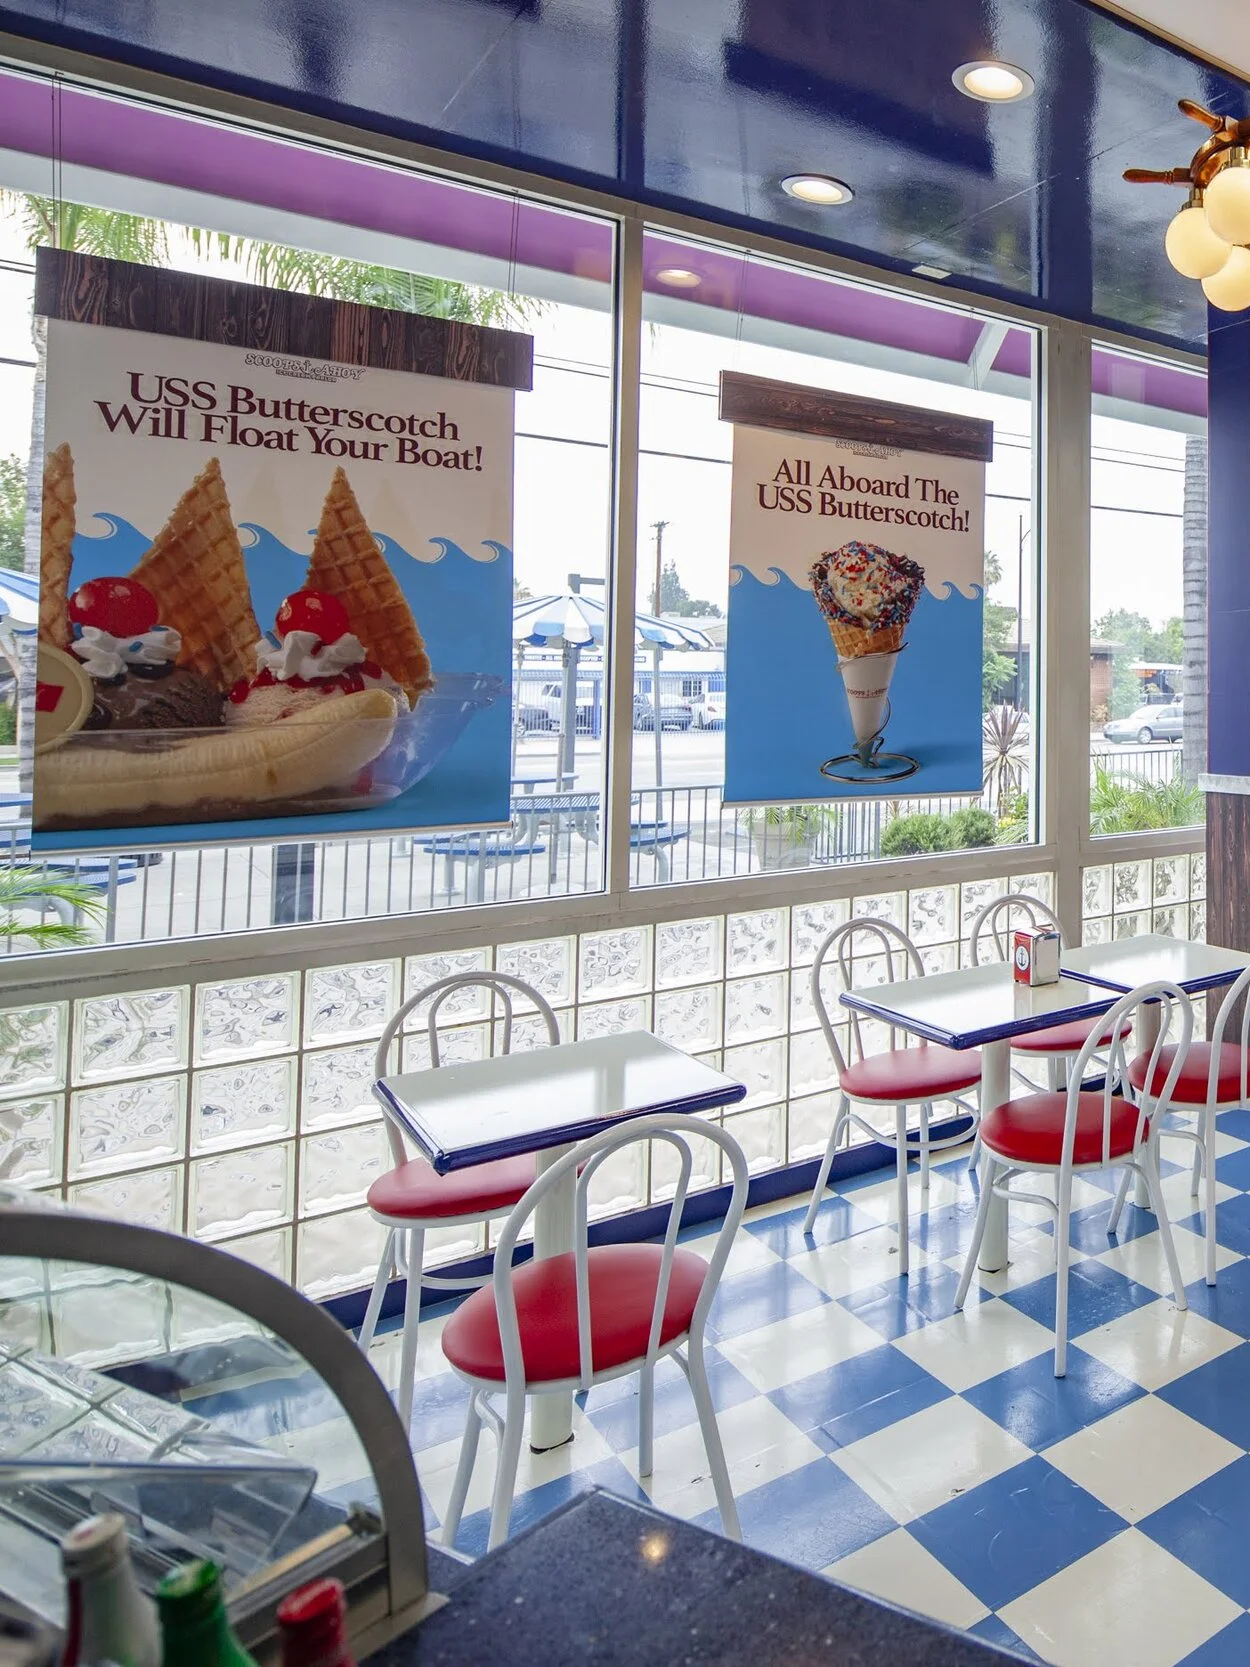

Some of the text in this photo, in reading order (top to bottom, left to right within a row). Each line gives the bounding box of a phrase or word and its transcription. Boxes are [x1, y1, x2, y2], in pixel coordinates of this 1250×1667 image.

[245, 353, 366, 380] SCOOPS AHOY
[126, 371, 460, 441] USS Butterscotch
[94, 400, 483, 472] Will Float Your Boat!
[772, 458, 959, 505] All Aboard The
[757, 483, 970, 532] USS Butterscotch!
